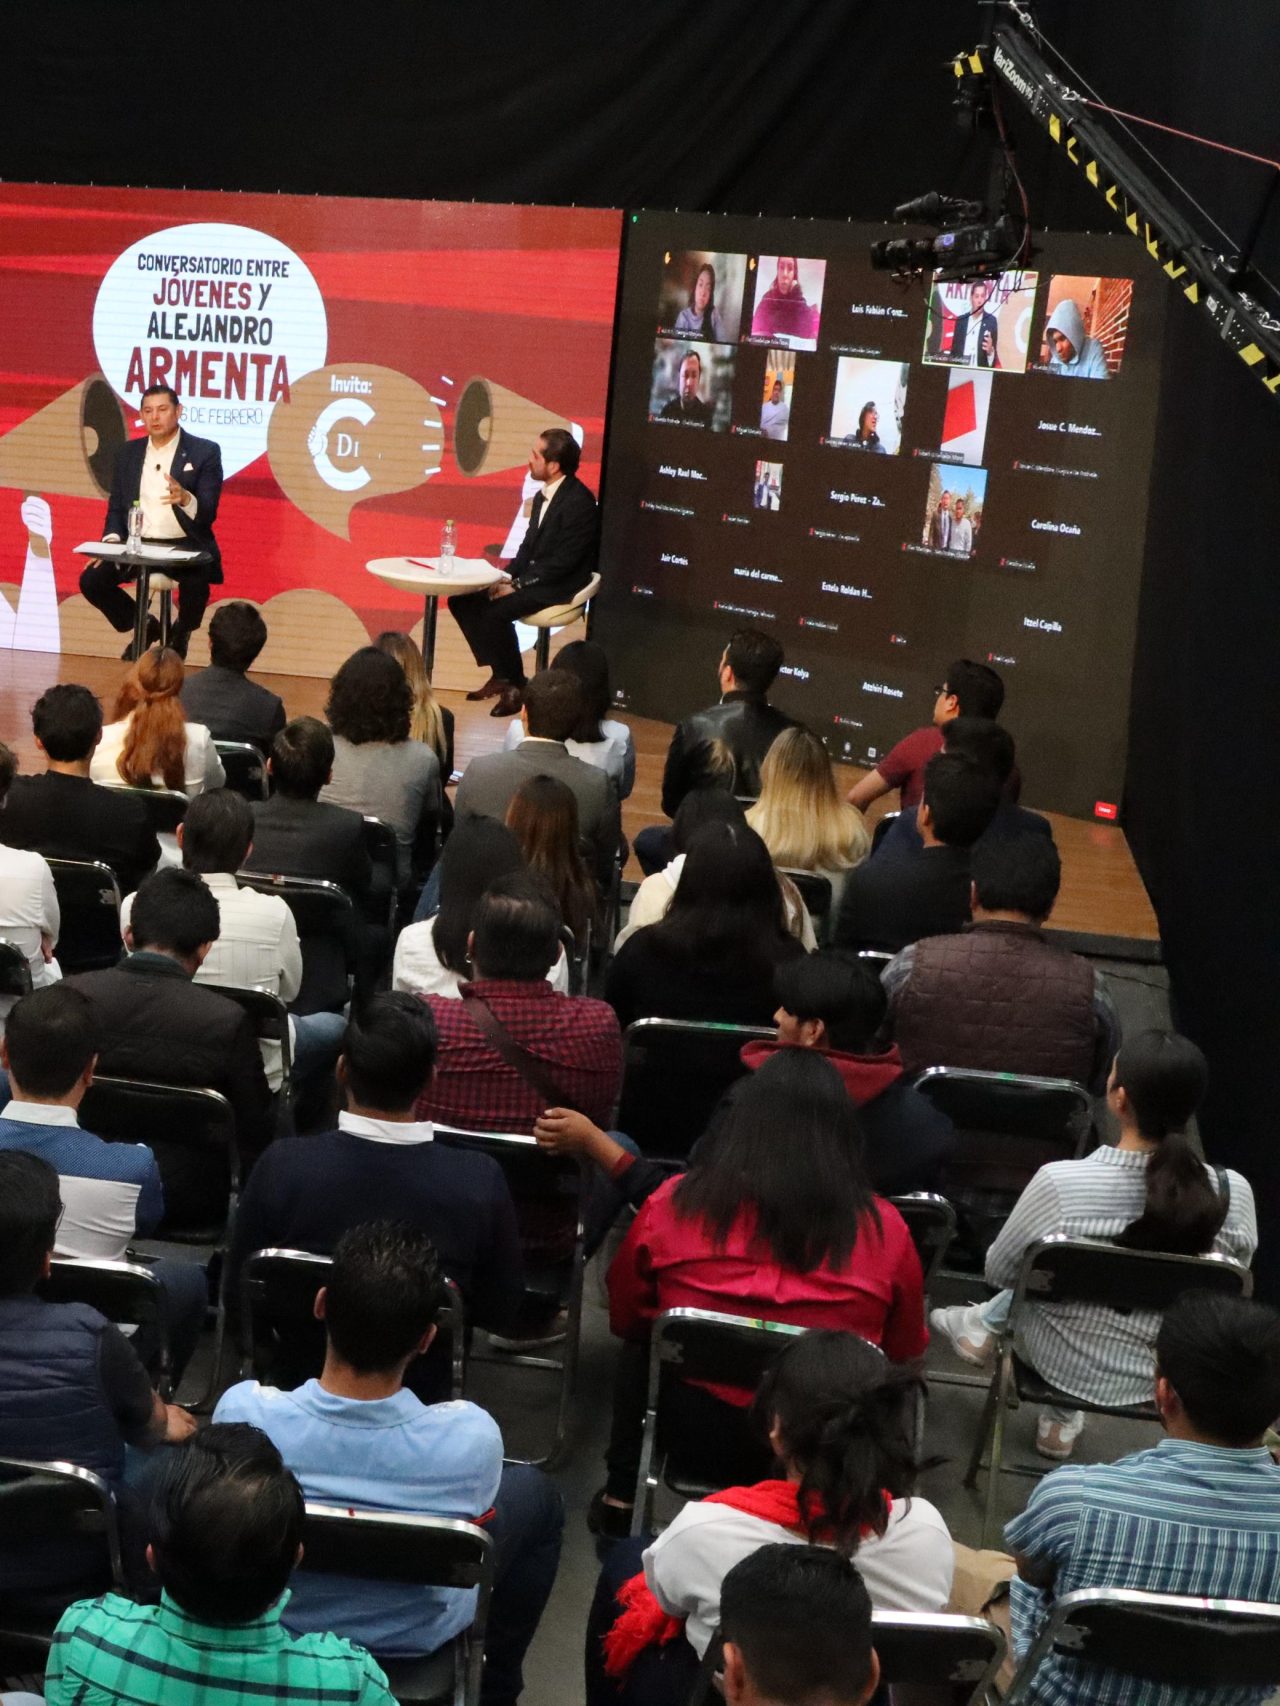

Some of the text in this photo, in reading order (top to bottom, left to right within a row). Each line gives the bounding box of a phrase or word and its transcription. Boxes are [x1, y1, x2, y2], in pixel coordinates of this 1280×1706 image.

[993, 46, 1026, 94] VariZoom
[138, 253, 290, 278] CONVERSATORIO ENTRE
[153, 269, 272, 311] JÓVENES Y
[147, 311, 273, 346] ALEJANDRO
[124, 346, 291, 405] ARMENTA
[330, 374, 373, 394] Invita:
[191, 406, 206, 423] DE
[208, 408, 263, 425] FEBRERO
[830, 491, 849, 503] Sergio
[1031, 519, 1058, 532] Carolina
[750, 569, 760, 578] del
[822, 581, 839, 592] Estela
[1039, 620, 1062, 632] Capilla
